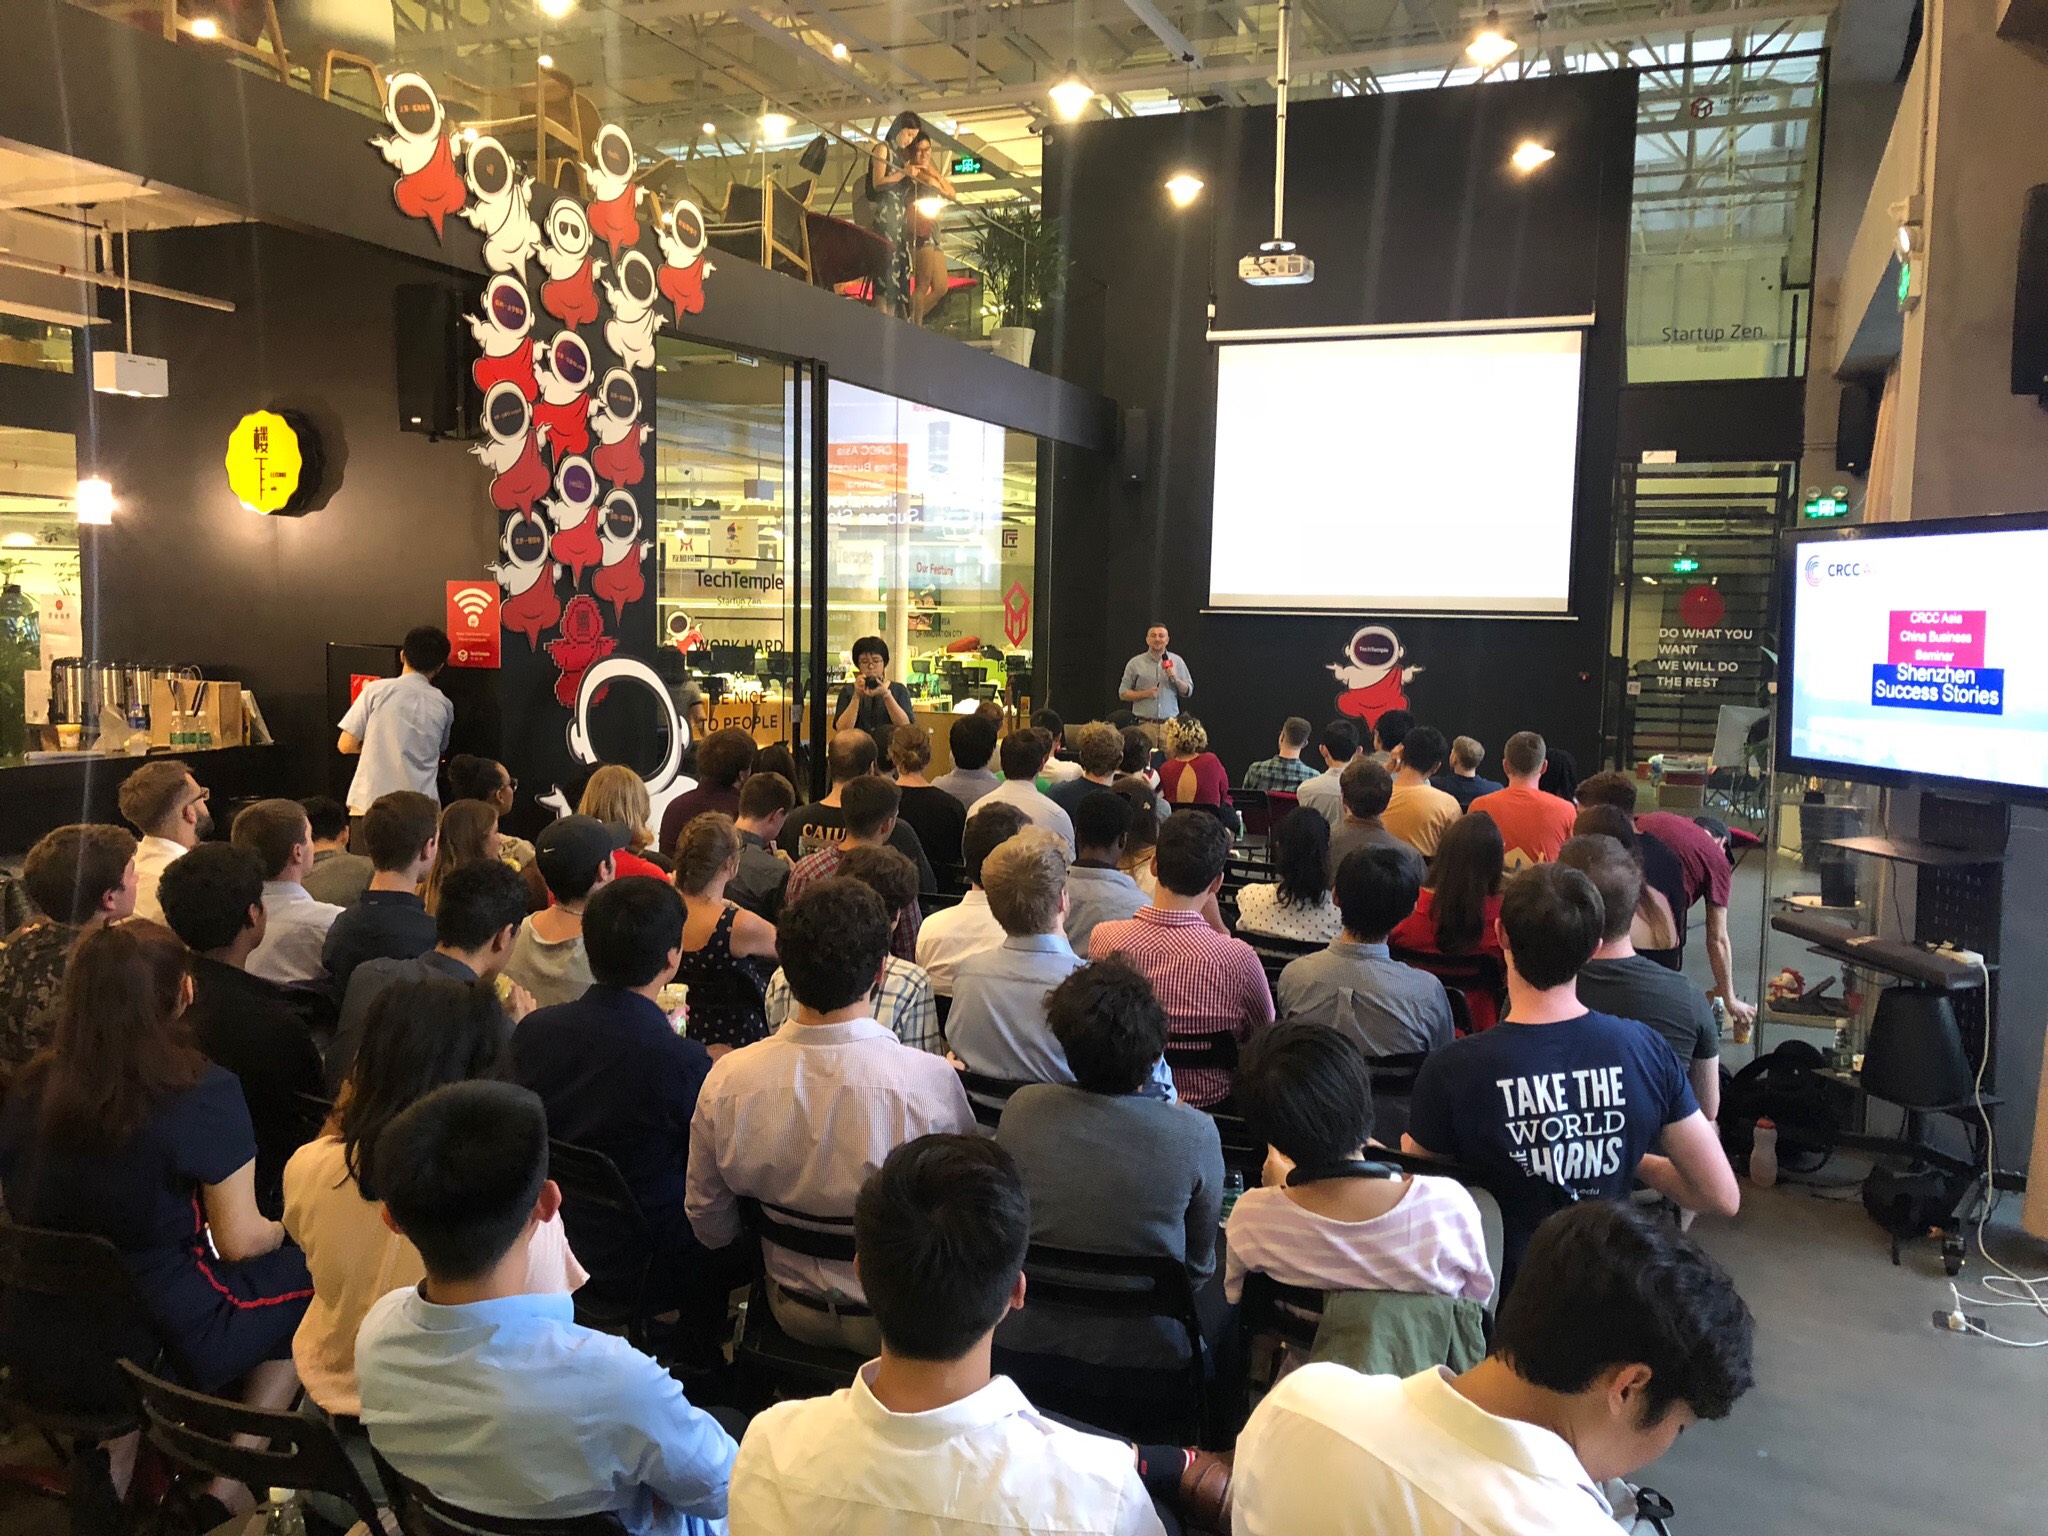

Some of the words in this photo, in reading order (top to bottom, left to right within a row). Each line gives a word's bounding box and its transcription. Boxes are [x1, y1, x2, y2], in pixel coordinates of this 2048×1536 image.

[1662, 326, 1725, 342] Startup
[1828, 563, 1860, 577] CRCC
[695, 569, 784, 593] TechTemple
[1910, 612, 1940, 624] CRCC
[1659, 628, 1679, 638] DO
[1682, 628, 1722, 639] WHAT
[1725, 629, 1753, 640] YOU
[1359, 646, 1389, 654] TechTemple
[1658, 644, 1699, 655] WANT
[1657, 660, 1680, 671] WE
[1682, 661, 1715, 672] WILL
[1718, 662, 1739, 672] DO
[1896, 662, 1976, 684] Shenzhen
[1657, 676, 1682, 688] THE
[1685, 677, 1719, 688] REST
[734, 690, 767, 705] NICE
[1875, 679, 1939, 701] Success
[1942, 683, 2000, 705] Stories
[700, 718, 719, 731] TO
[1496, 1073, 1569, 1118] TAKE
[1572, 1066, 1626, 1108] THE
[1505, 1111, 1626, 1145] WORLD
